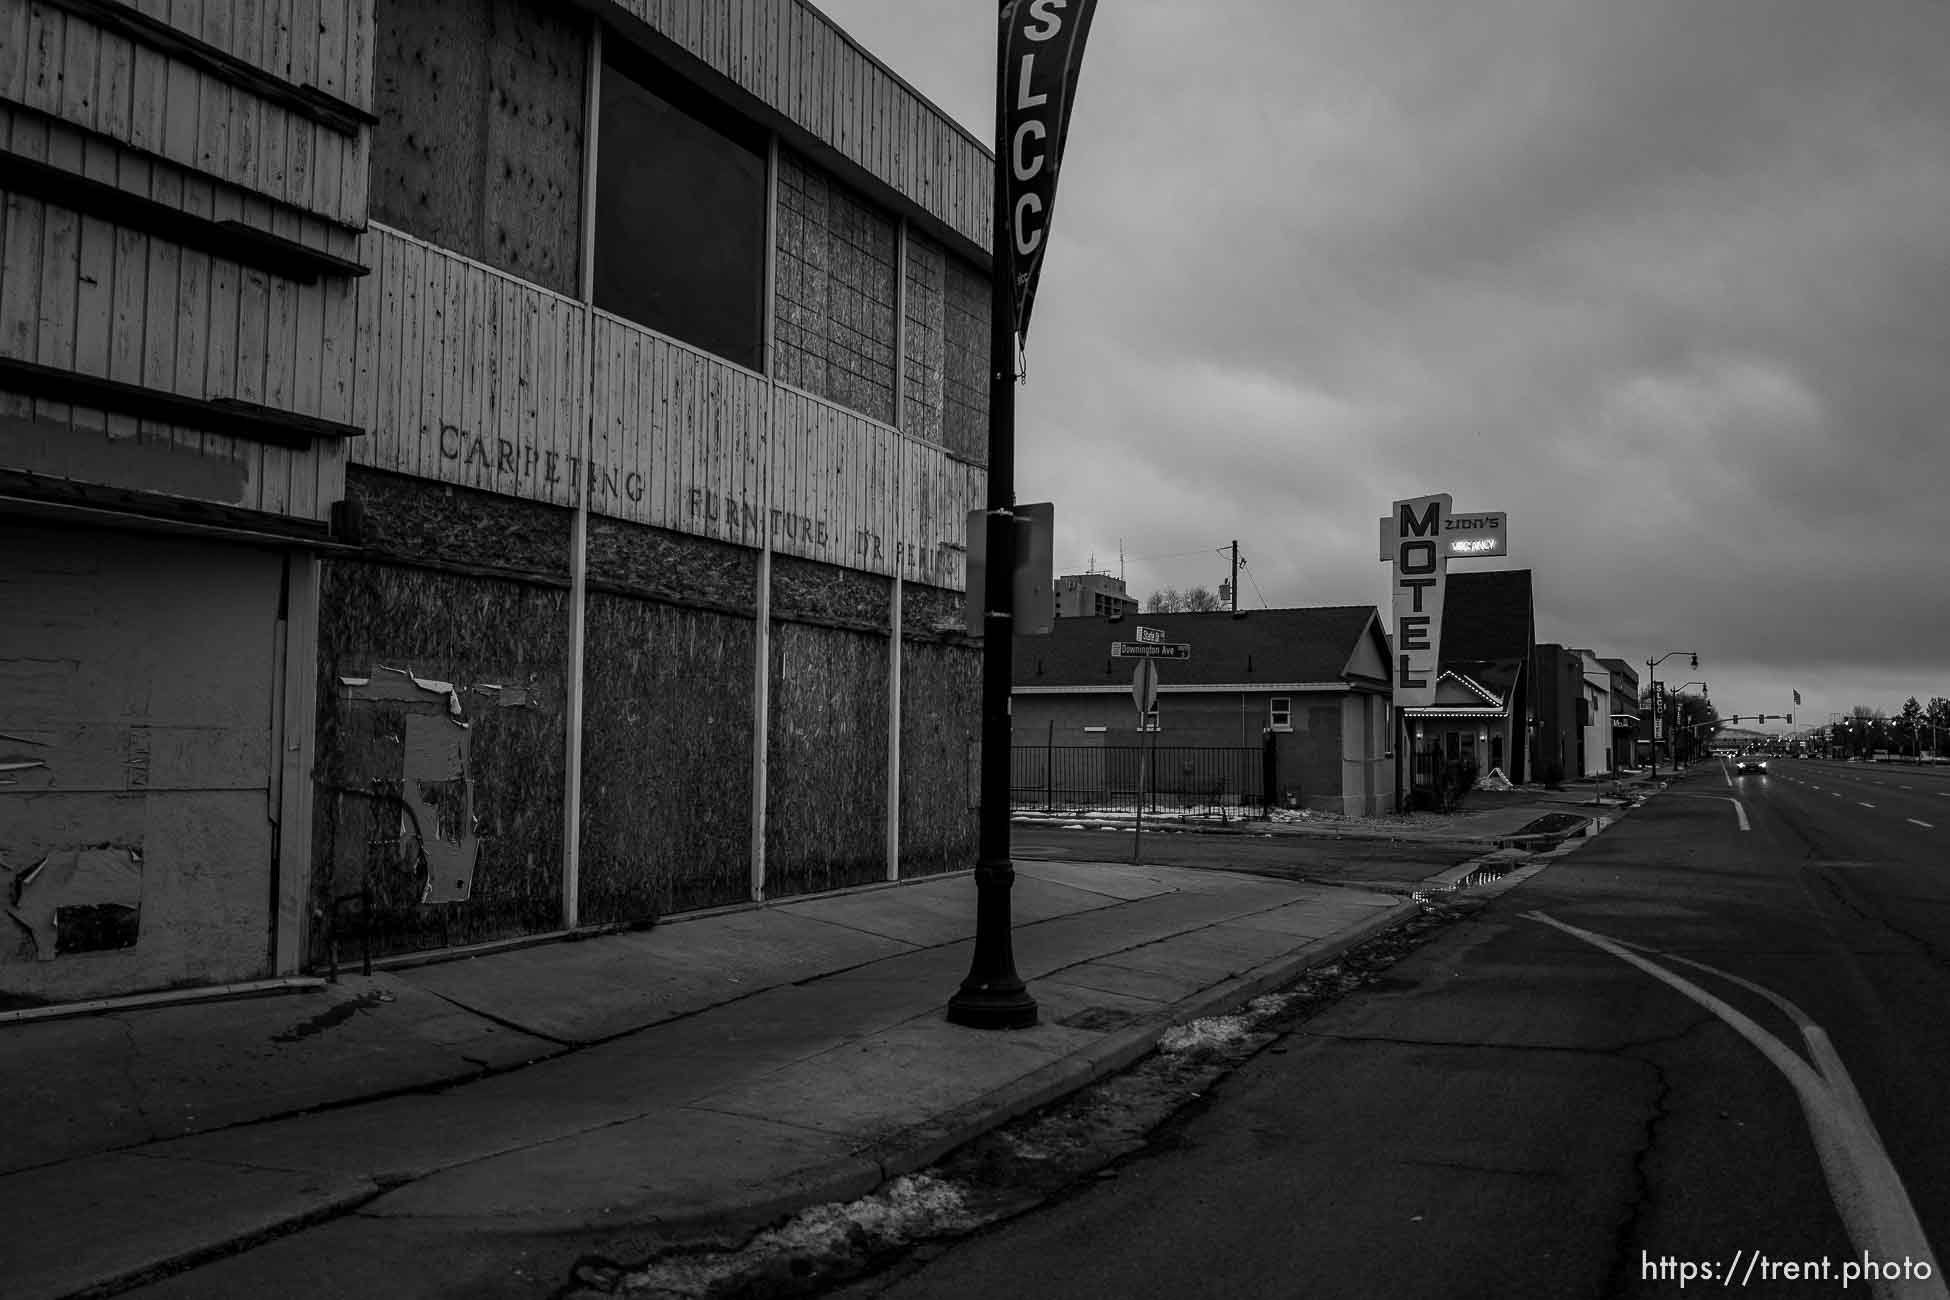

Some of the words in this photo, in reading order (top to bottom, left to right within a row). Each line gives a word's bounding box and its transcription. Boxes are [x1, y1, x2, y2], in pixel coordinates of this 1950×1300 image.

[1012, 0, 1067, 256] SLCC
[440, 424, 646, 502] CARPETING
[688, 488, 831, 547] FURNTURE
[1161, 645, 1175, 656] Ave
[1399, 502, 1440, 689] MOTEL
